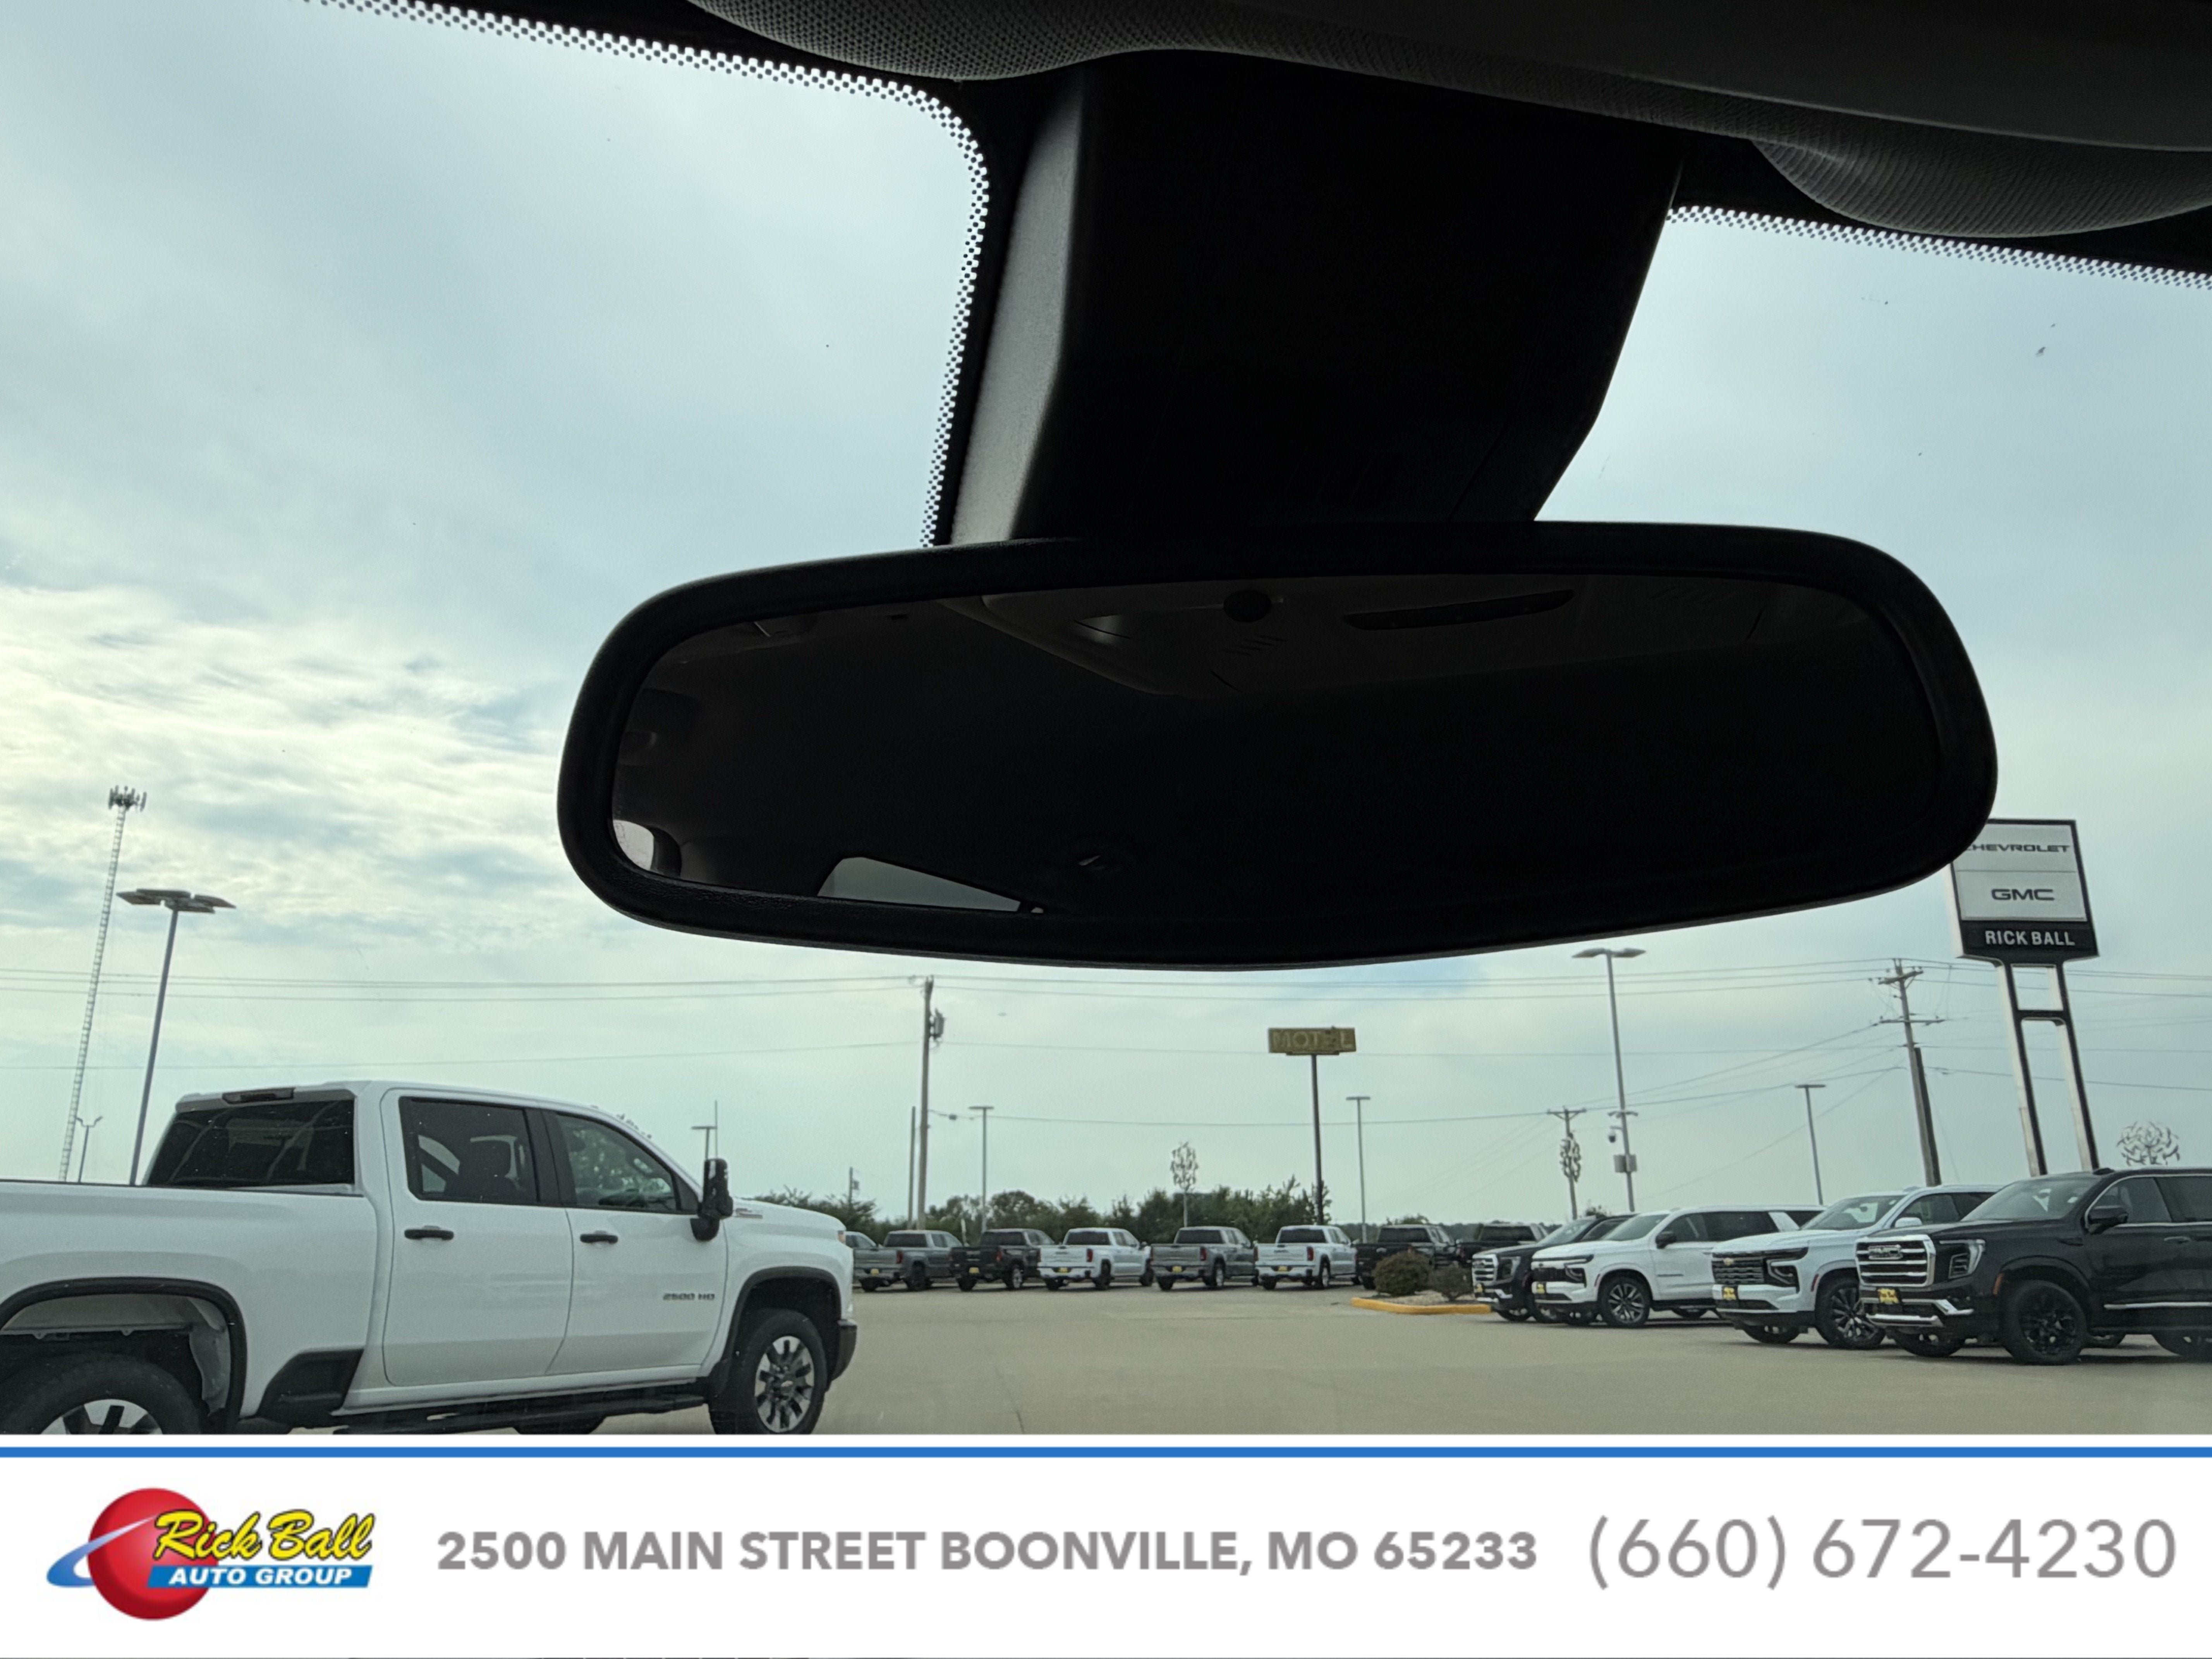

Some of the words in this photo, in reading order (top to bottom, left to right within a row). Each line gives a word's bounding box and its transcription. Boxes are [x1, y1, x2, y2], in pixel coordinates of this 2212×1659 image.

[1967, 844, 2070, 852] HEVROLET
[1990, 889, 2055, 901] GMC
[1985, 931, 2028, 945] RICK
[2032, 931, 2075, 946] BALL
